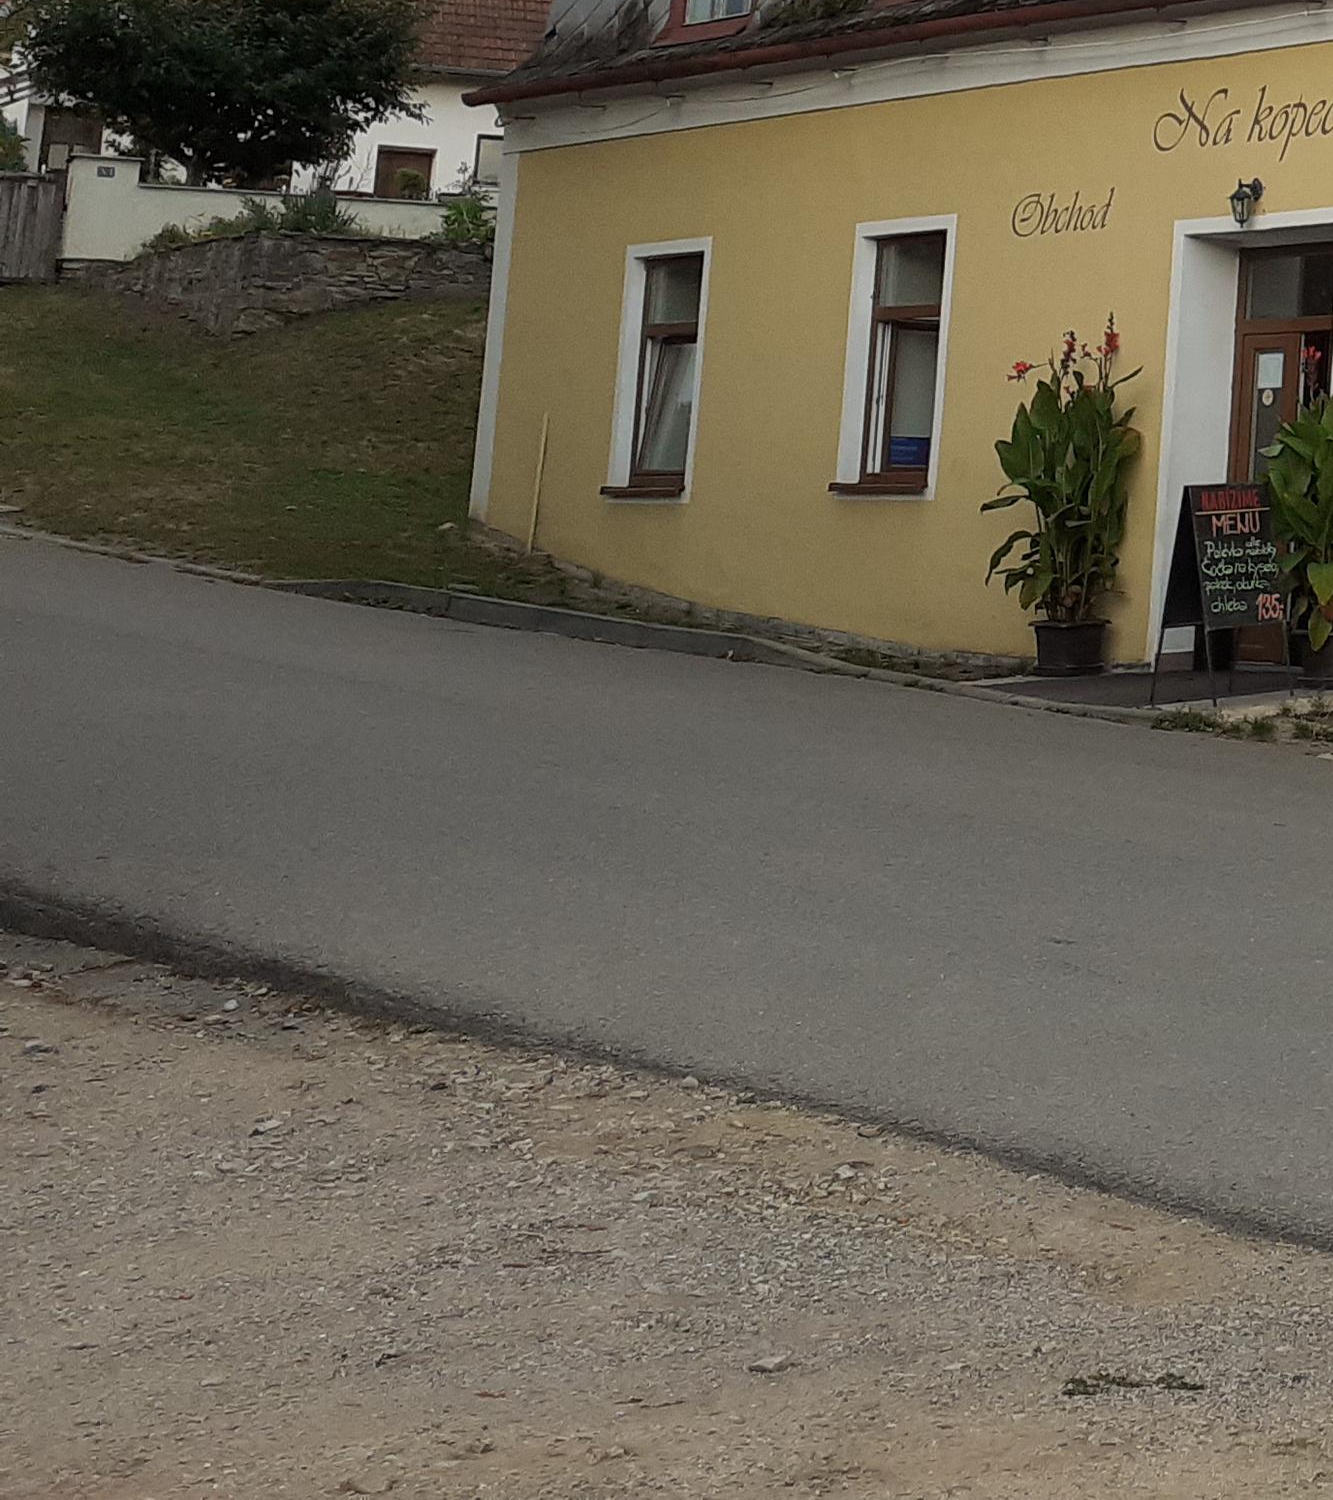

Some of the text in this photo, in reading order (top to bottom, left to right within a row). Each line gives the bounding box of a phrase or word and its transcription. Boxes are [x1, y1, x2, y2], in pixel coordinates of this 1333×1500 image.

[1153, 87, 1240, 152] Na
[1011, 186, 1115, 238] Obchod
[1211, 511, 1260, 538] MENU
